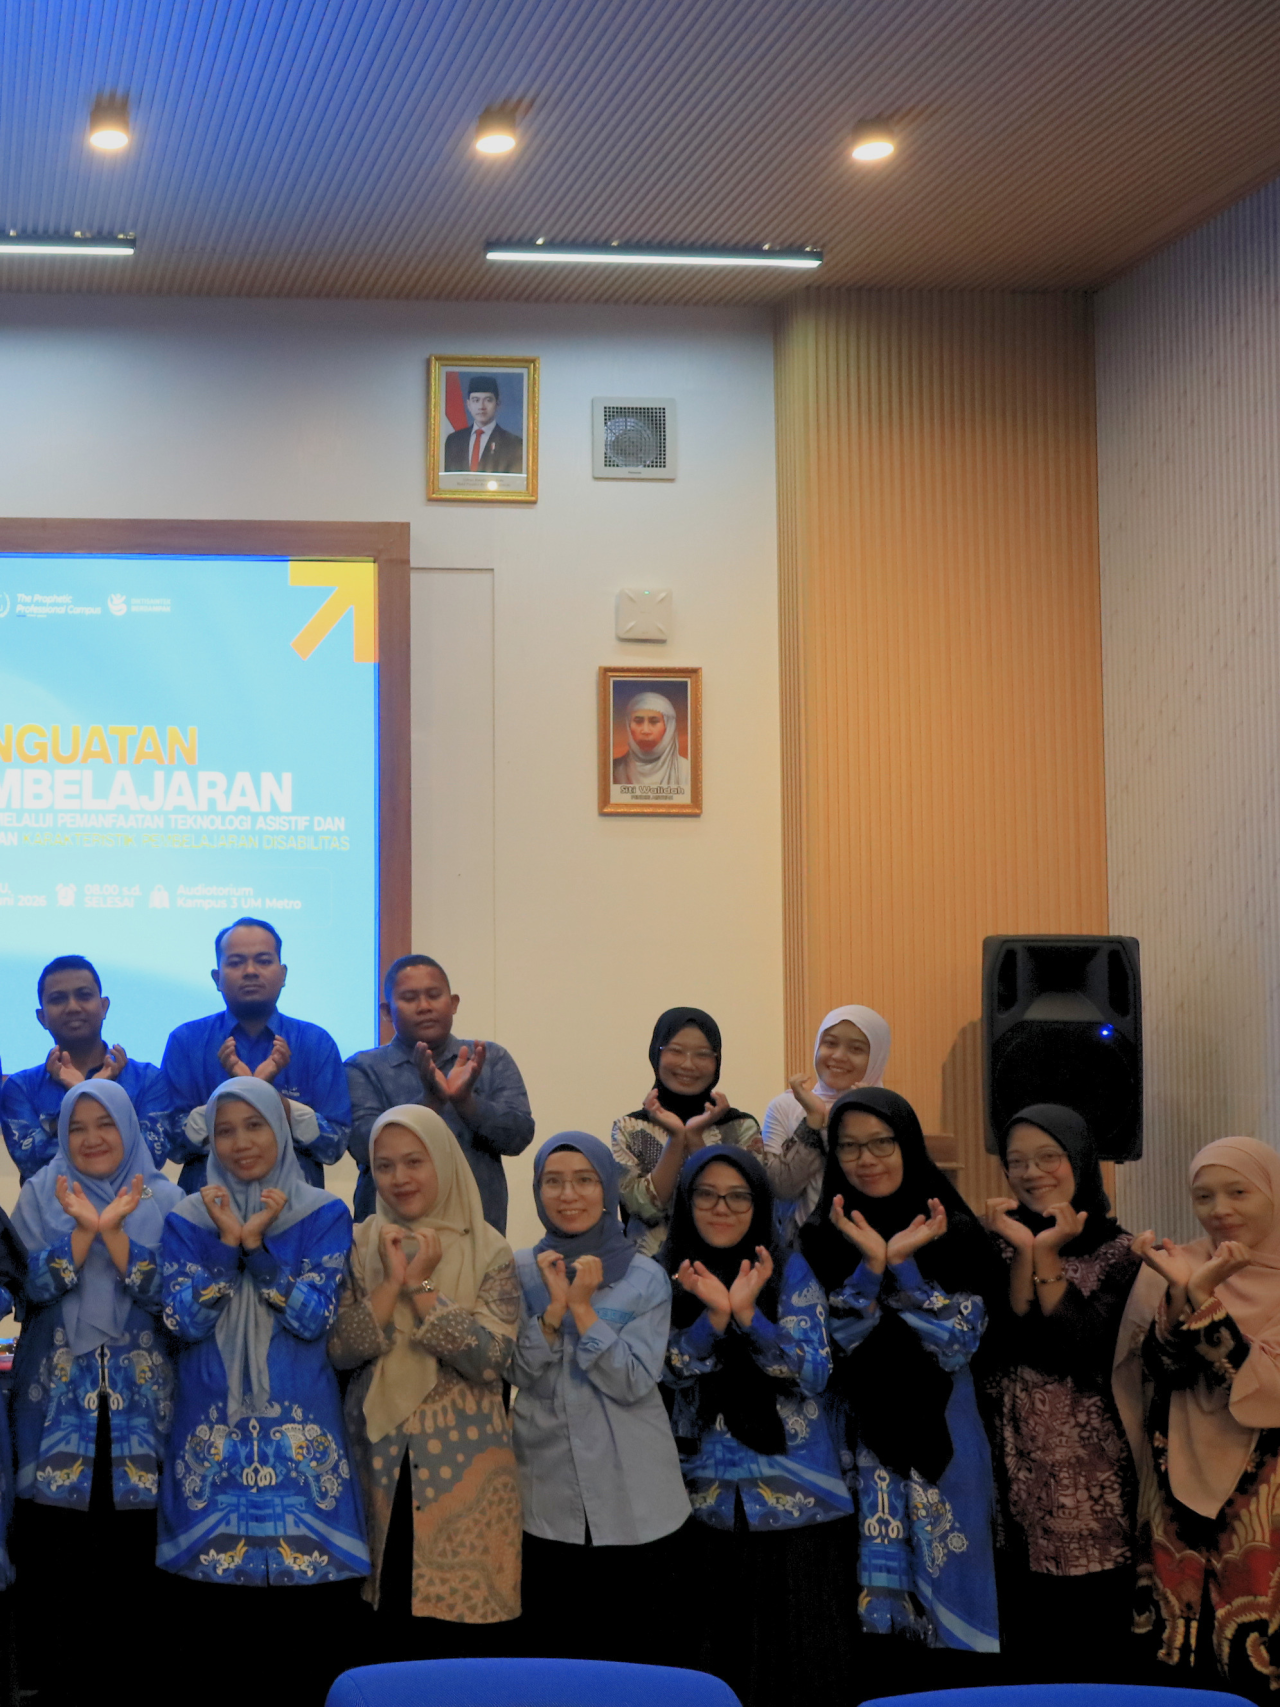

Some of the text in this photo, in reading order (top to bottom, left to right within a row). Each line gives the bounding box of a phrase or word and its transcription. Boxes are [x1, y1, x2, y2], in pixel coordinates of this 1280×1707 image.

[16, 593, 72, 606] The Prophetic
[16, 603, 101, 616] Professional Campus
[620, 785, 685, 795] Siti Walidah
[57, 813, 164, 829] PEMANFAATAN
[168, 814, 251, 830] TEKNOLOGI
[255, 815, 310, 831] ASISTIF
[313, 816, 345, 831] DAN
[23, 832, 137, 847] KARAKTERISTIK
[142, 833, 259, 849] PEMBELAJARAN
[263, 834, 350, 850] DISABILITAS
[84, 884, 142, 896] 08.00 s.d.
[176, 883, 254, 896] Audiotorium
[18, 895, 47, 906] 2026
[84, 896, 134, 908] SELESAI
[176, 897, 302, 910] Kampus 3 UM Metro
